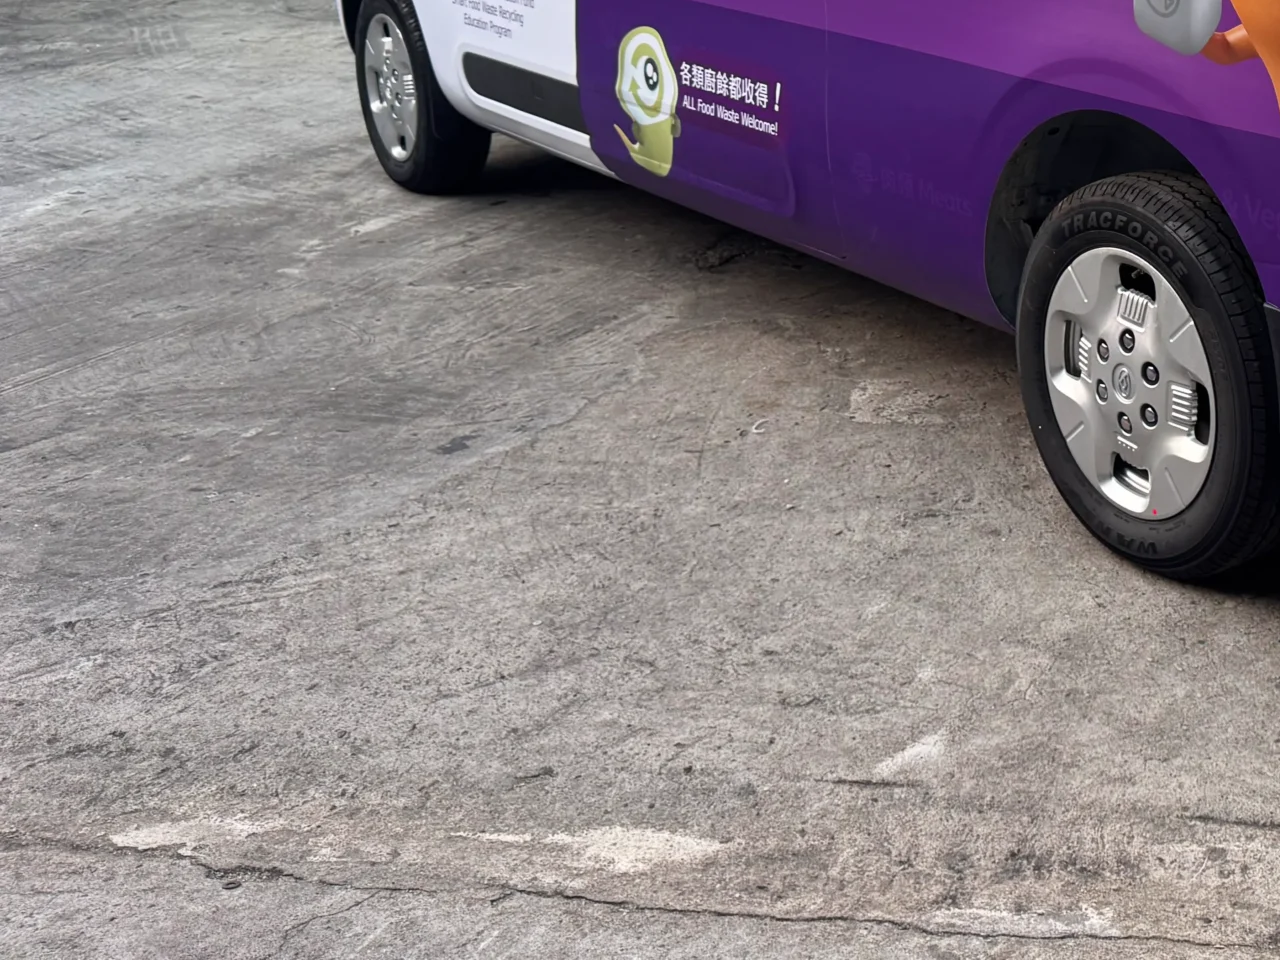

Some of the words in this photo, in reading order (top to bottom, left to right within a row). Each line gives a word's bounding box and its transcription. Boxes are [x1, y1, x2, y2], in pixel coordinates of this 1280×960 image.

[464, 12, 488, 30] Education
[489, 20, 512, 38] Program
[481, 1, 498, 16] Waste
[499, 5, 524, 27] Recycling
[682, 94, 696, 111] ALL
[697, 98, 715, 116] Food
[716, 104, 740, 124] Waste
[740, 111, 778, 136] Welcome!
[1061, 211, 1187, 279] TRACFORCE
